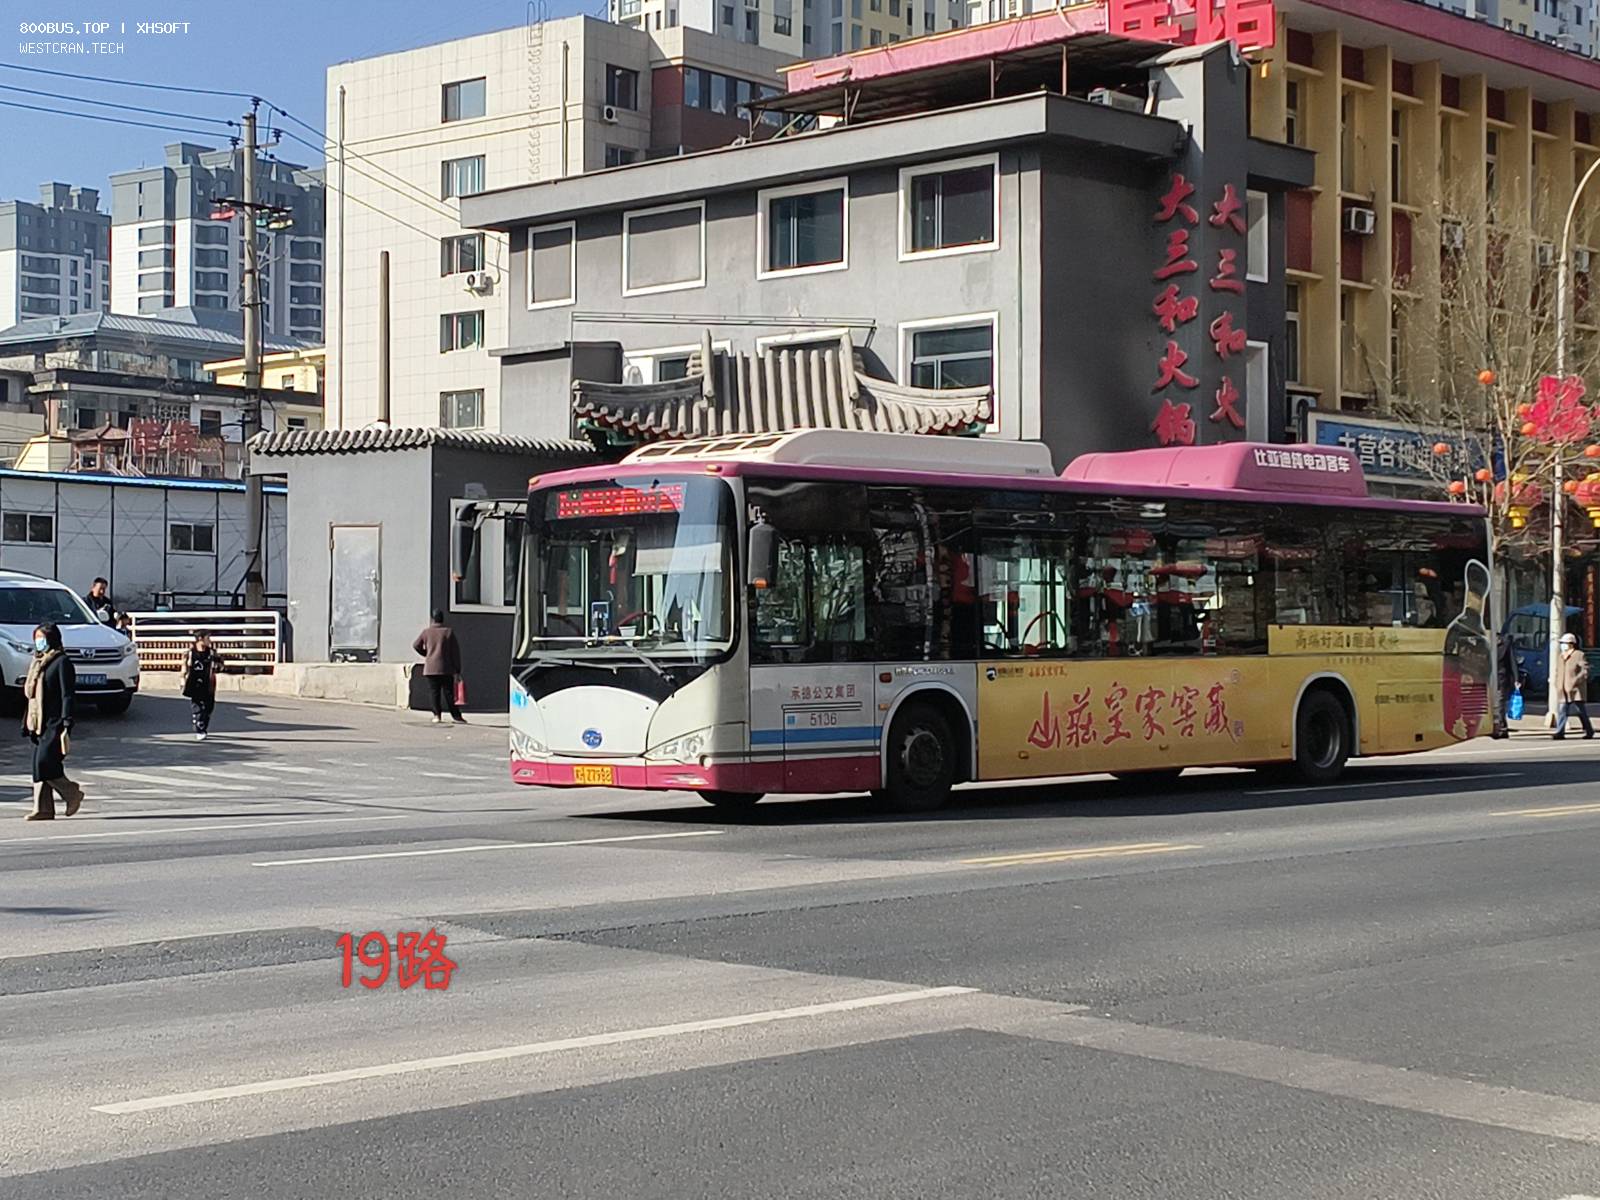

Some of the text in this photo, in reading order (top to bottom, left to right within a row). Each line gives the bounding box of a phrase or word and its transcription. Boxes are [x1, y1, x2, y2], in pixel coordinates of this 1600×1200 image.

[1153, 173, 1199, 445] 大三和火锅
[1208, 182, 1247, 443] 大三和火
[1254, 449, 1351, 473] 比亚迪纯电动客车
